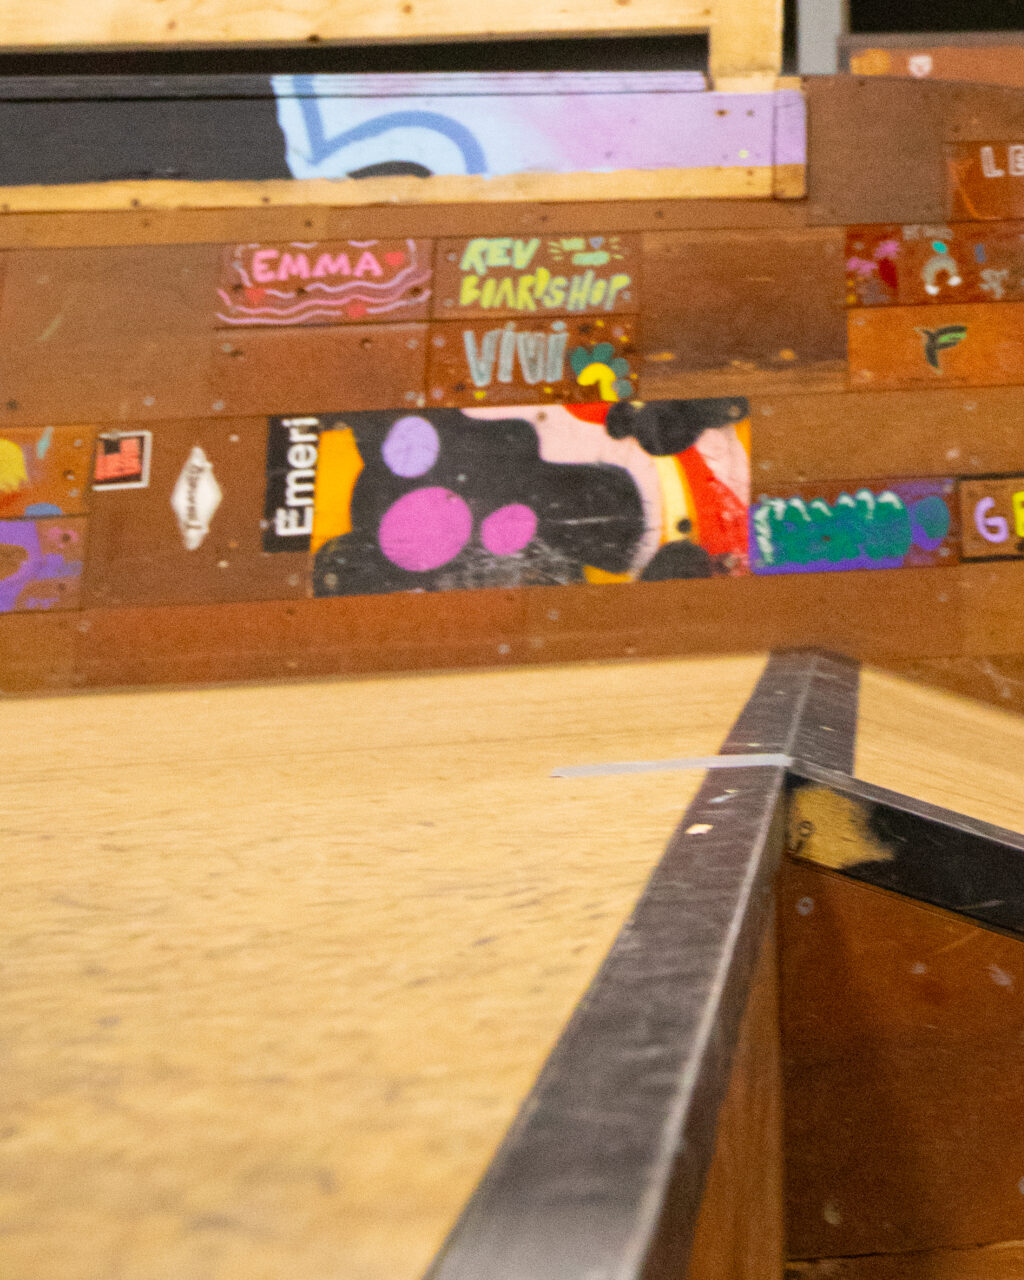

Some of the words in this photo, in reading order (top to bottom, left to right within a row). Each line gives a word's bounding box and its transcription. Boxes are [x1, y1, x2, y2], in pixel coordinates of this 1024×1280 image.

[251, 249, 383, 283] EMMA
[460, 238, 540, 274] REV
[274, 416, 320, 537] Emeri
